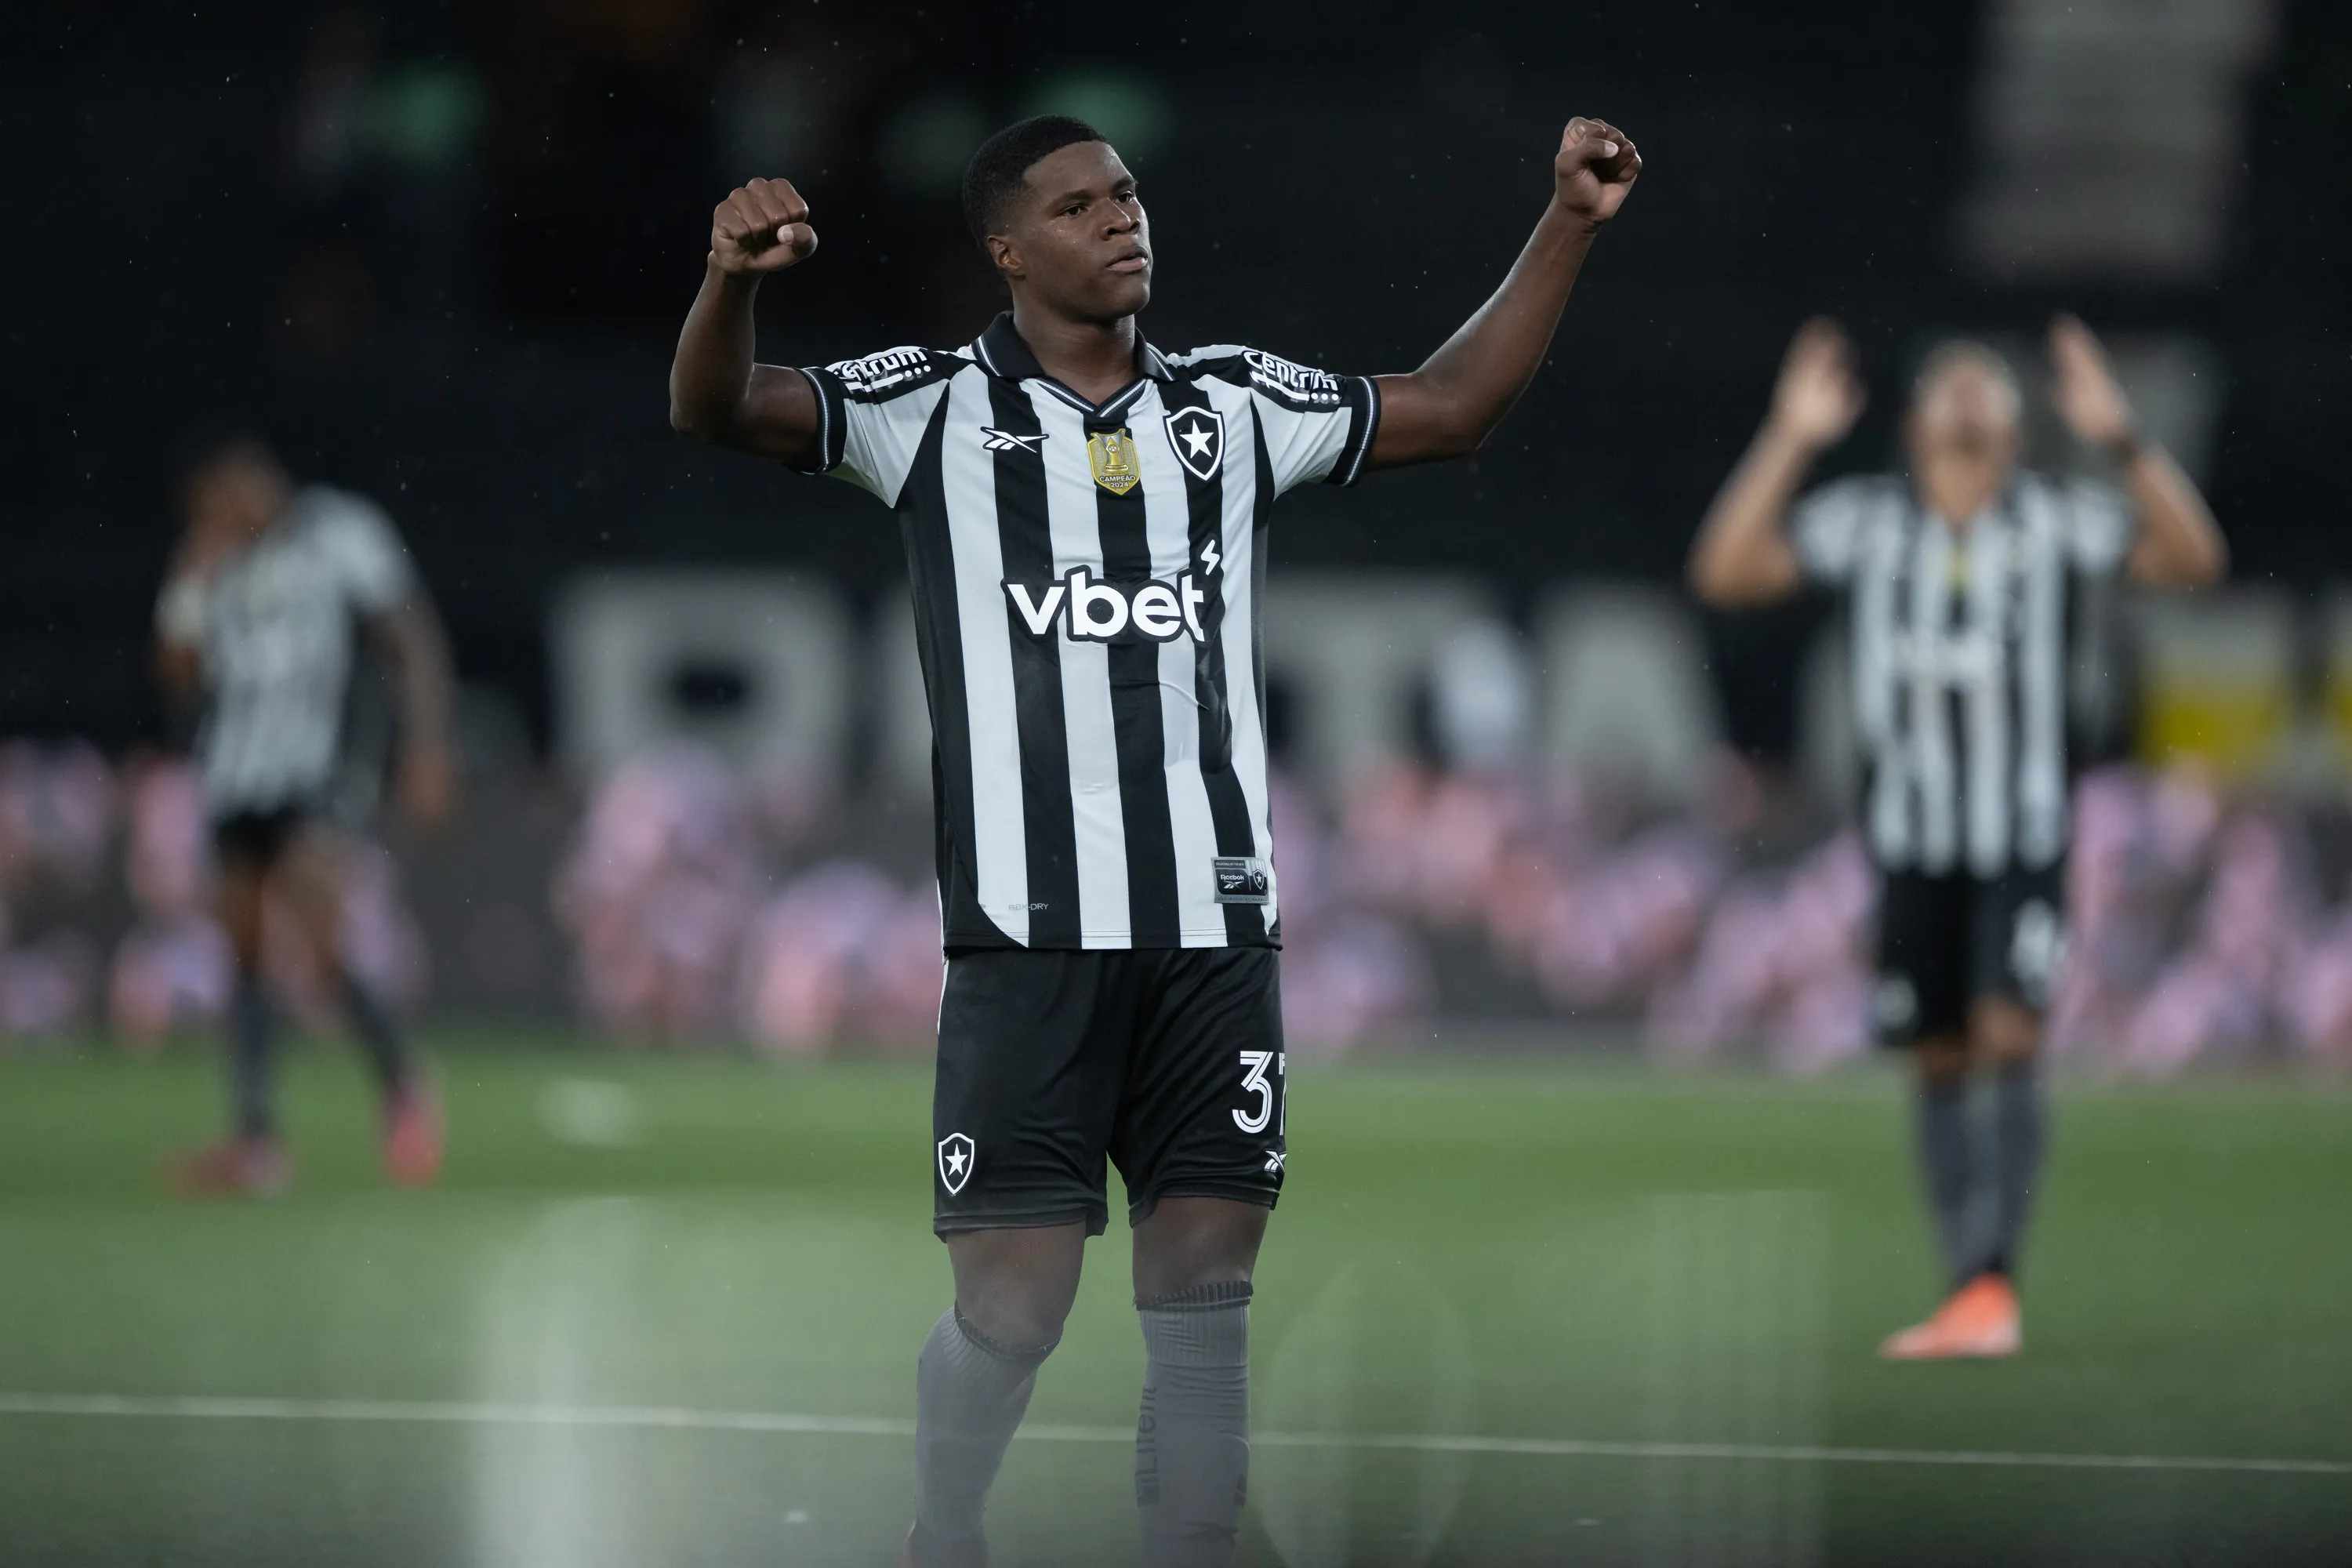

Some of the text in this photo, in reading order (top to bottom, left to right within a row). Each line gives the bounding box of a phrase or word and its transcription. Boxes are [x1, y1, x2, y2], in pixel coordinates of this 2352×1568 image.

[833, 350, 927, 382] entrum
[1243, 350, 1339, 391] Centrm
[1099, 474, 1136, 482] CAMPEÃO
[1007, 570, 1206, 642] vbet
